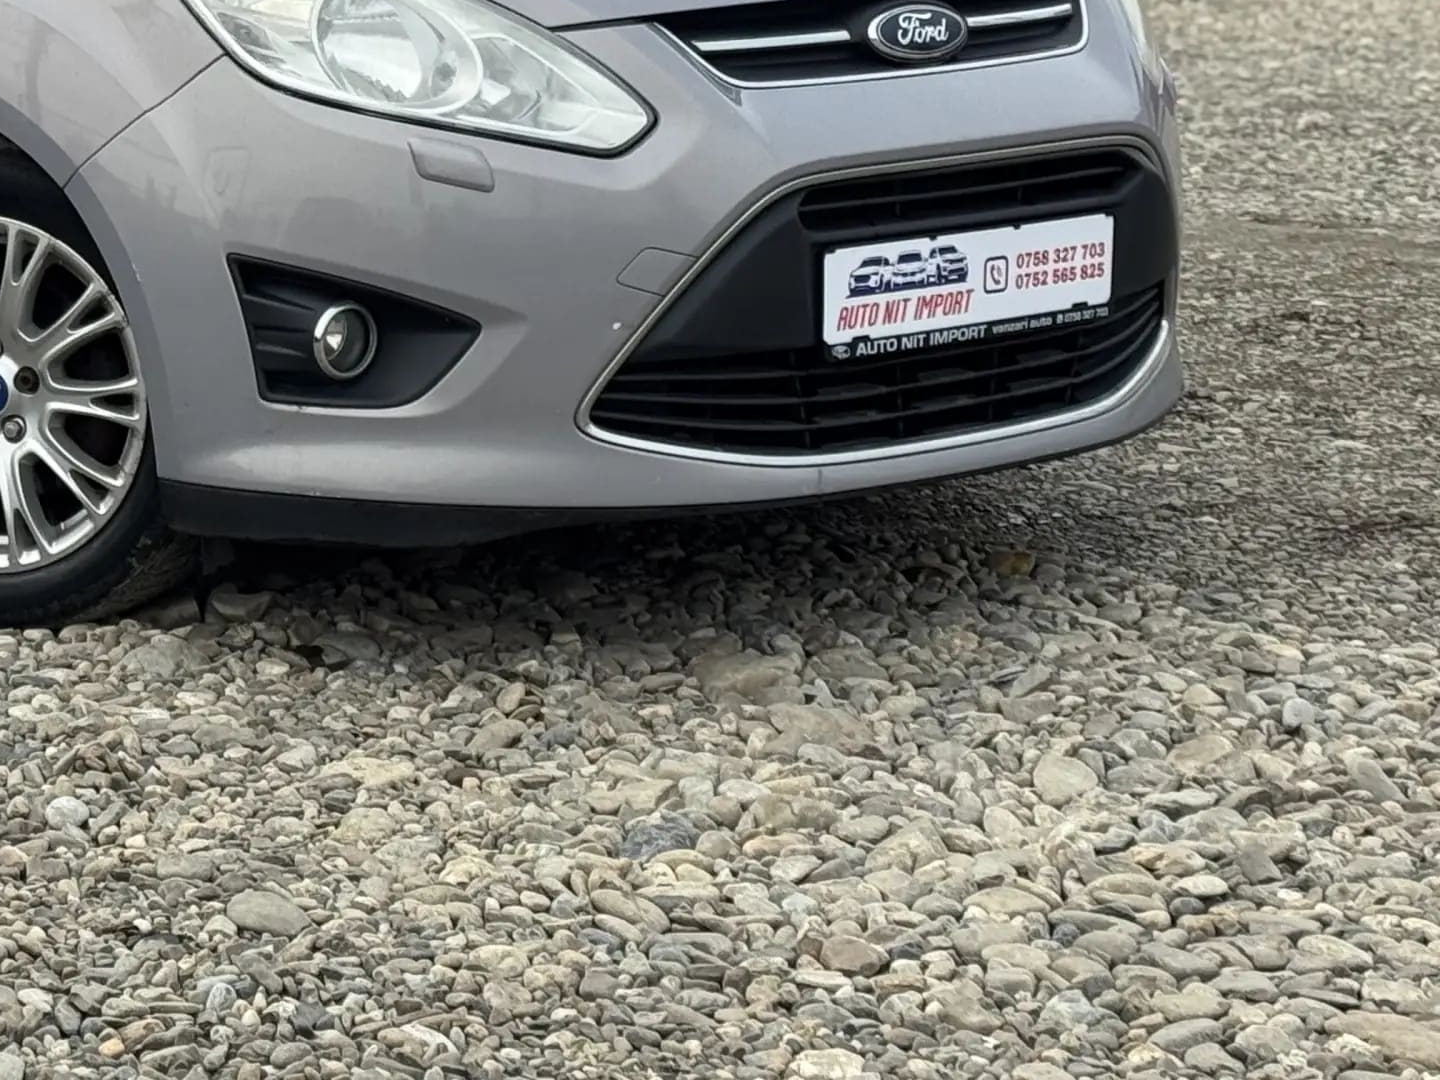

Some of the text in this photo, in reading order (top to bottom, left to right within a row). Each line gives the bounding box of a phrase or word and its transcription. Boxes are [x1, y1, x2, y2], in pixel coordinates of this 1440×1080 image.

[897, 12, 949, 45] Ford
[1016, 242, 1105, 269] 0758 327 703
[1015, 263, 1105, 290] 0752 565 825
[836, 289, 975, 332] AUTO NIT IMPORT
[856, 338, 898, 357] AUTO
[901, 333, 928, 351] NIT
[930, 325, 987, 346] IMPORT
